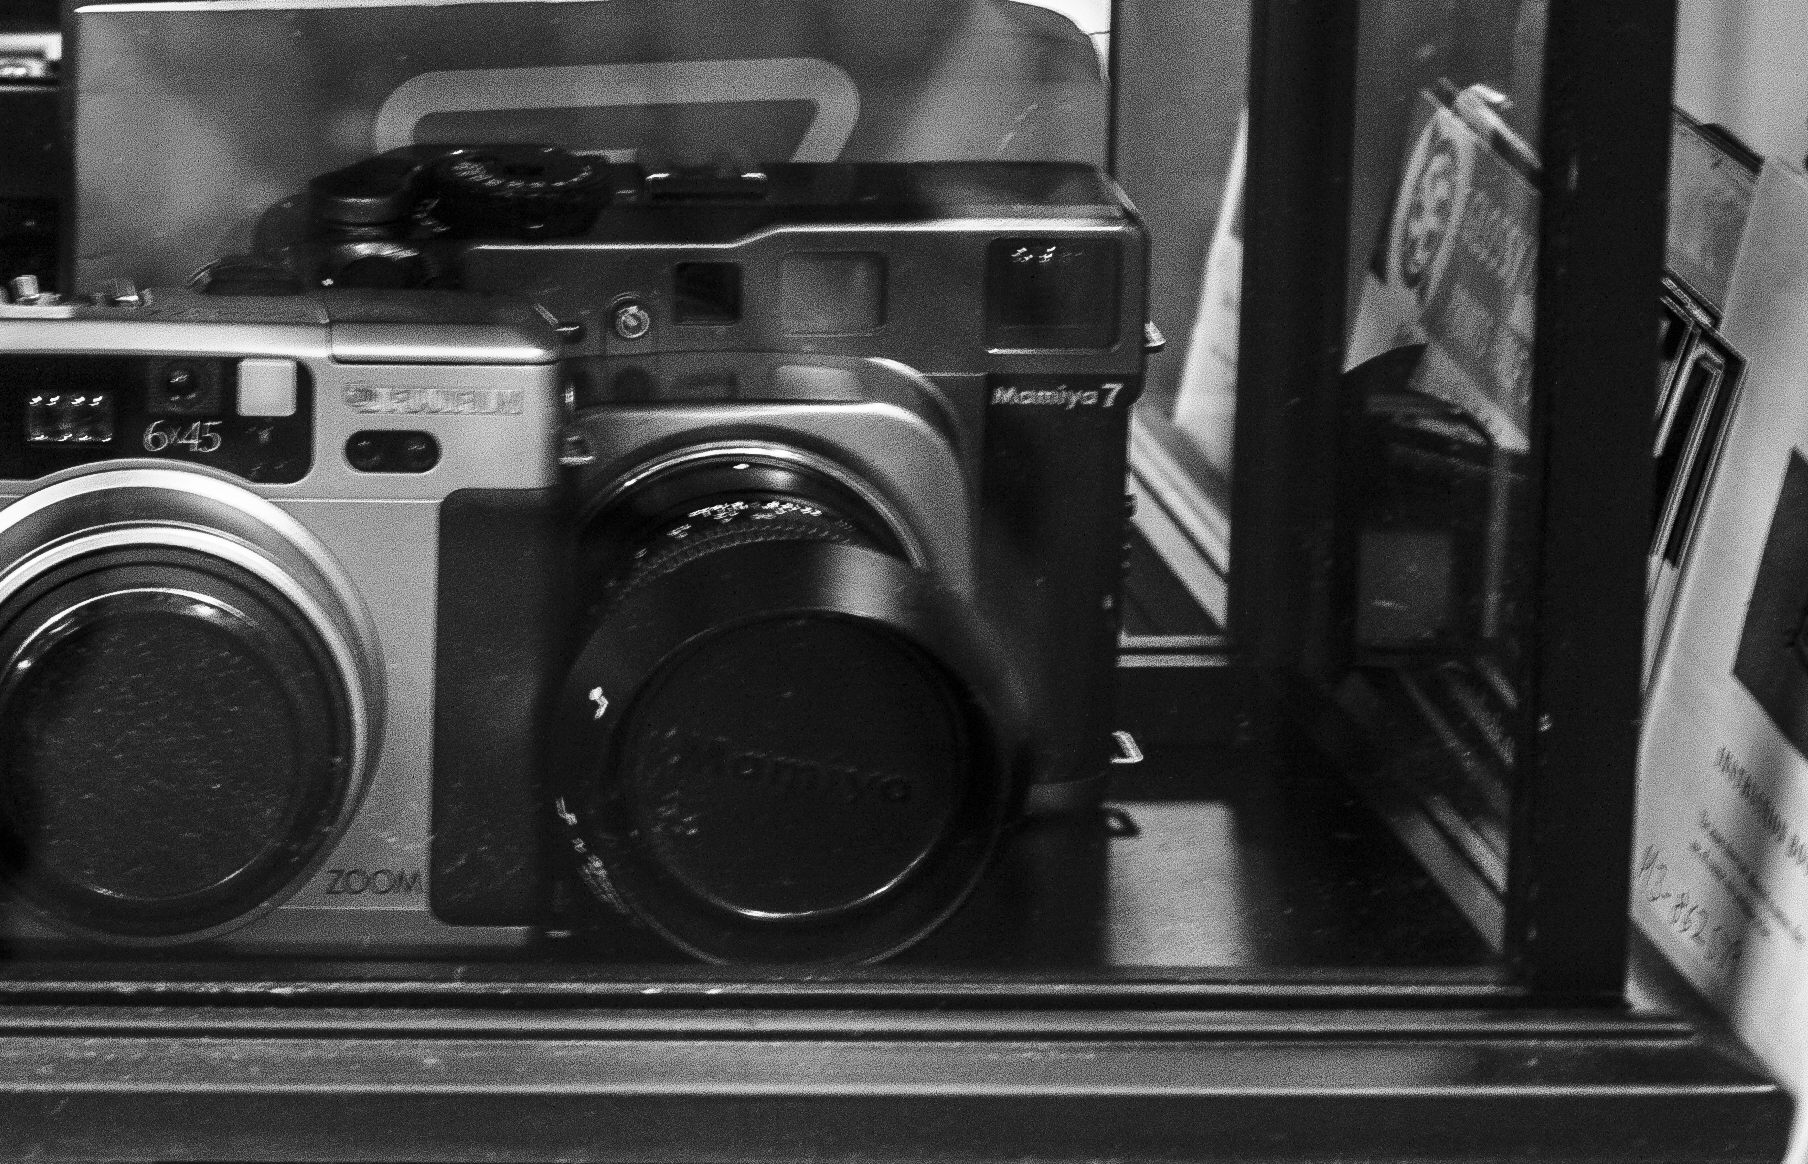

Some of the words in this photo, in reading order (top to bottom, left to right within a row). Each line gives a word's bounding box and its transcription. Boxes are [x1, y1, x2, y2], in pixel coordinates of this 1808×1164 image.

[990, 384, 1100, 411] Mamiya
[1100, 382, 1125, 409] 7
[326, 869, 424, 896] ZOOM
